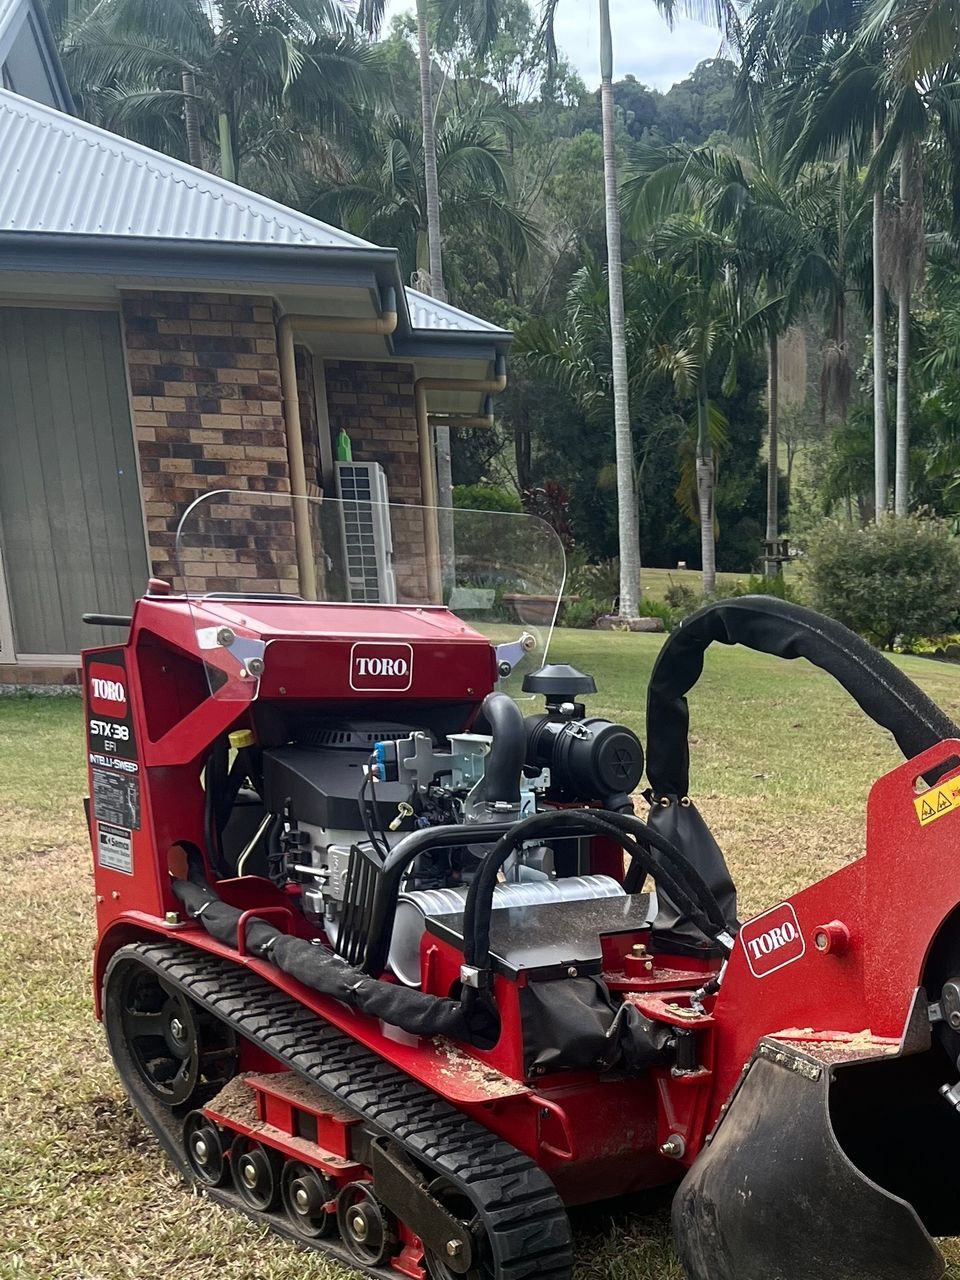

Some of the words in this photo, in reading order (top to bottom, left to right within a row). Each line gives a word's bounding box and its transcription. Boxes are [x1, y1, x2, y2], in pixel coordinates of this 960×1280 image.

[356, 657, 408, 676] TORO
[91, 678, 125, 702] TORO
[104, 740, 117, 752] EFI
[89, 753, 139, 773] INTELLI-SWEEP
[747, 921, 797, 960] TORO
